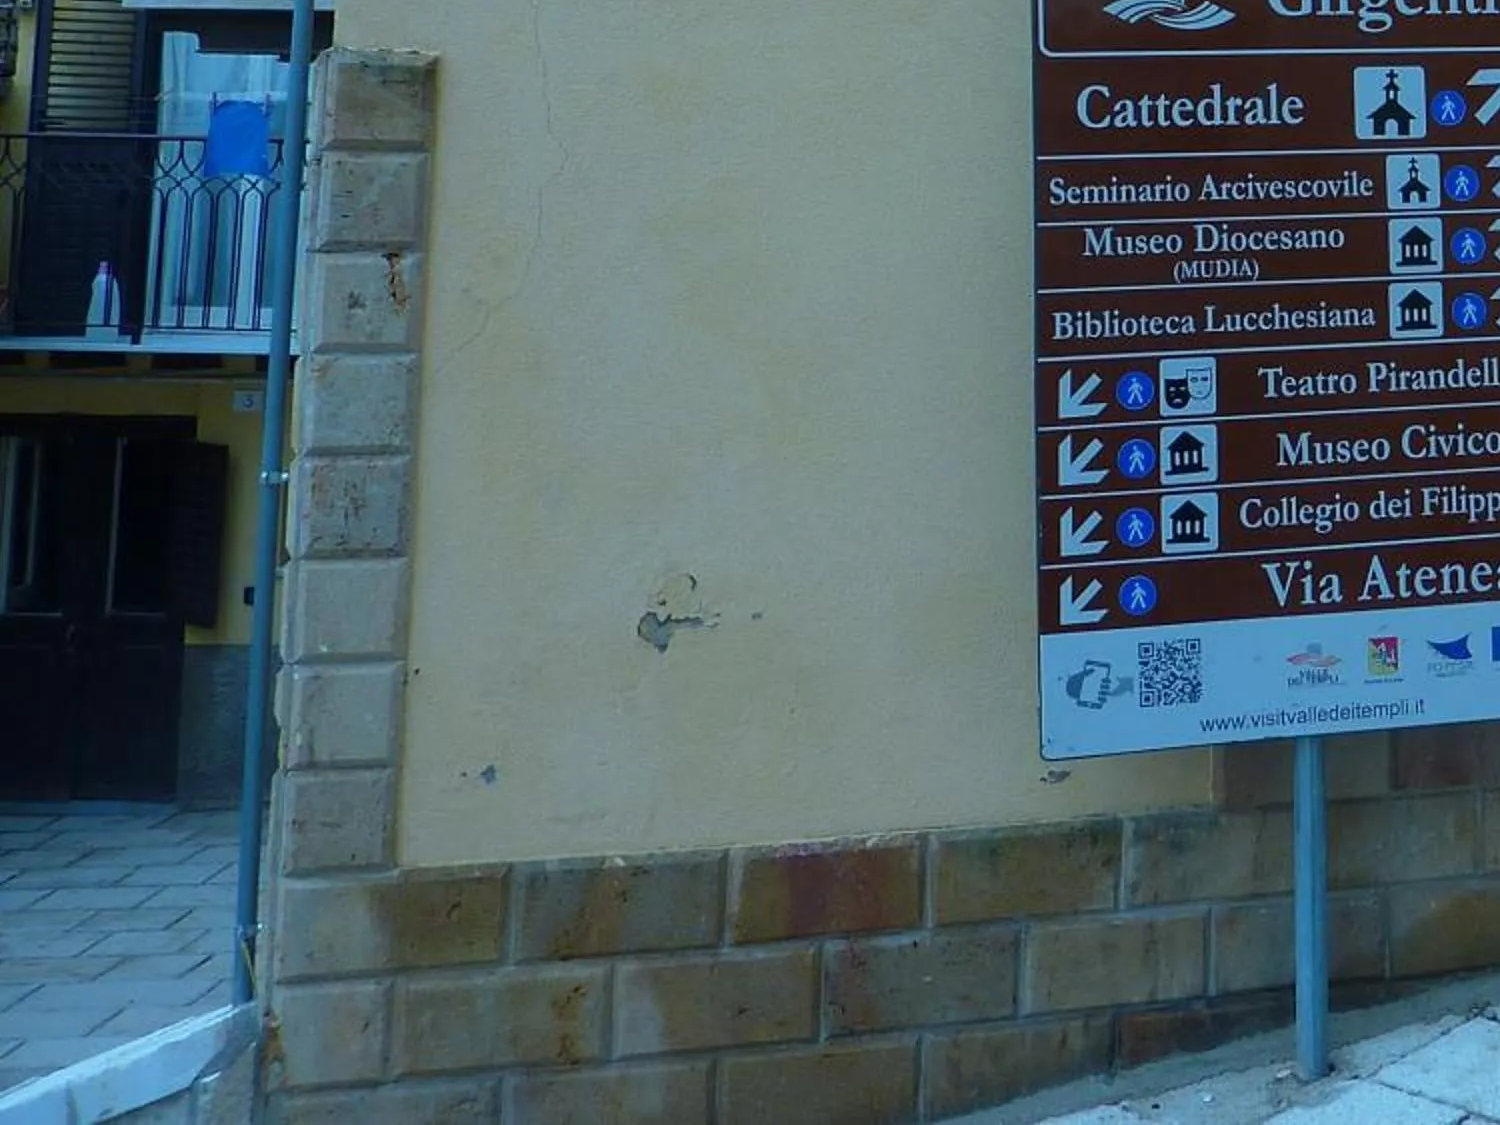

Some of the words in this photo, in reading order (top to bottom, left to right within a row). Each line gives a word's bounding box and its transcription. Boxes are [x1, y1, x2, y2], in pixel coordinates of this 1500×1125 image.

[1075, 82, 1305, 128] Cattedrale
[1048, 175, 1191, 206] Seminario
[1199, 170, 1374, 201] Arcivescovile
[1083, 227, 1183, 257] Museo
[1193, 223, 1345, 253] Diocesano
[1173, 259, 1260, 284] (MUDIA)
[1053, 310, 1196, 340] Biblioteca
[1204, 304, 1376, 334] Lucchesiana
[1257, 366, 1358, 398] Teatro
[1276, 431, 1391, 467] Museo
[1239, 494, 1360, 533] Collegio
[1368, 487, 1413, 519] dei
[1262, 561, 1343, 607] Via
[1200, 699, 1426, 732] www.visitvalledeitempli.it
